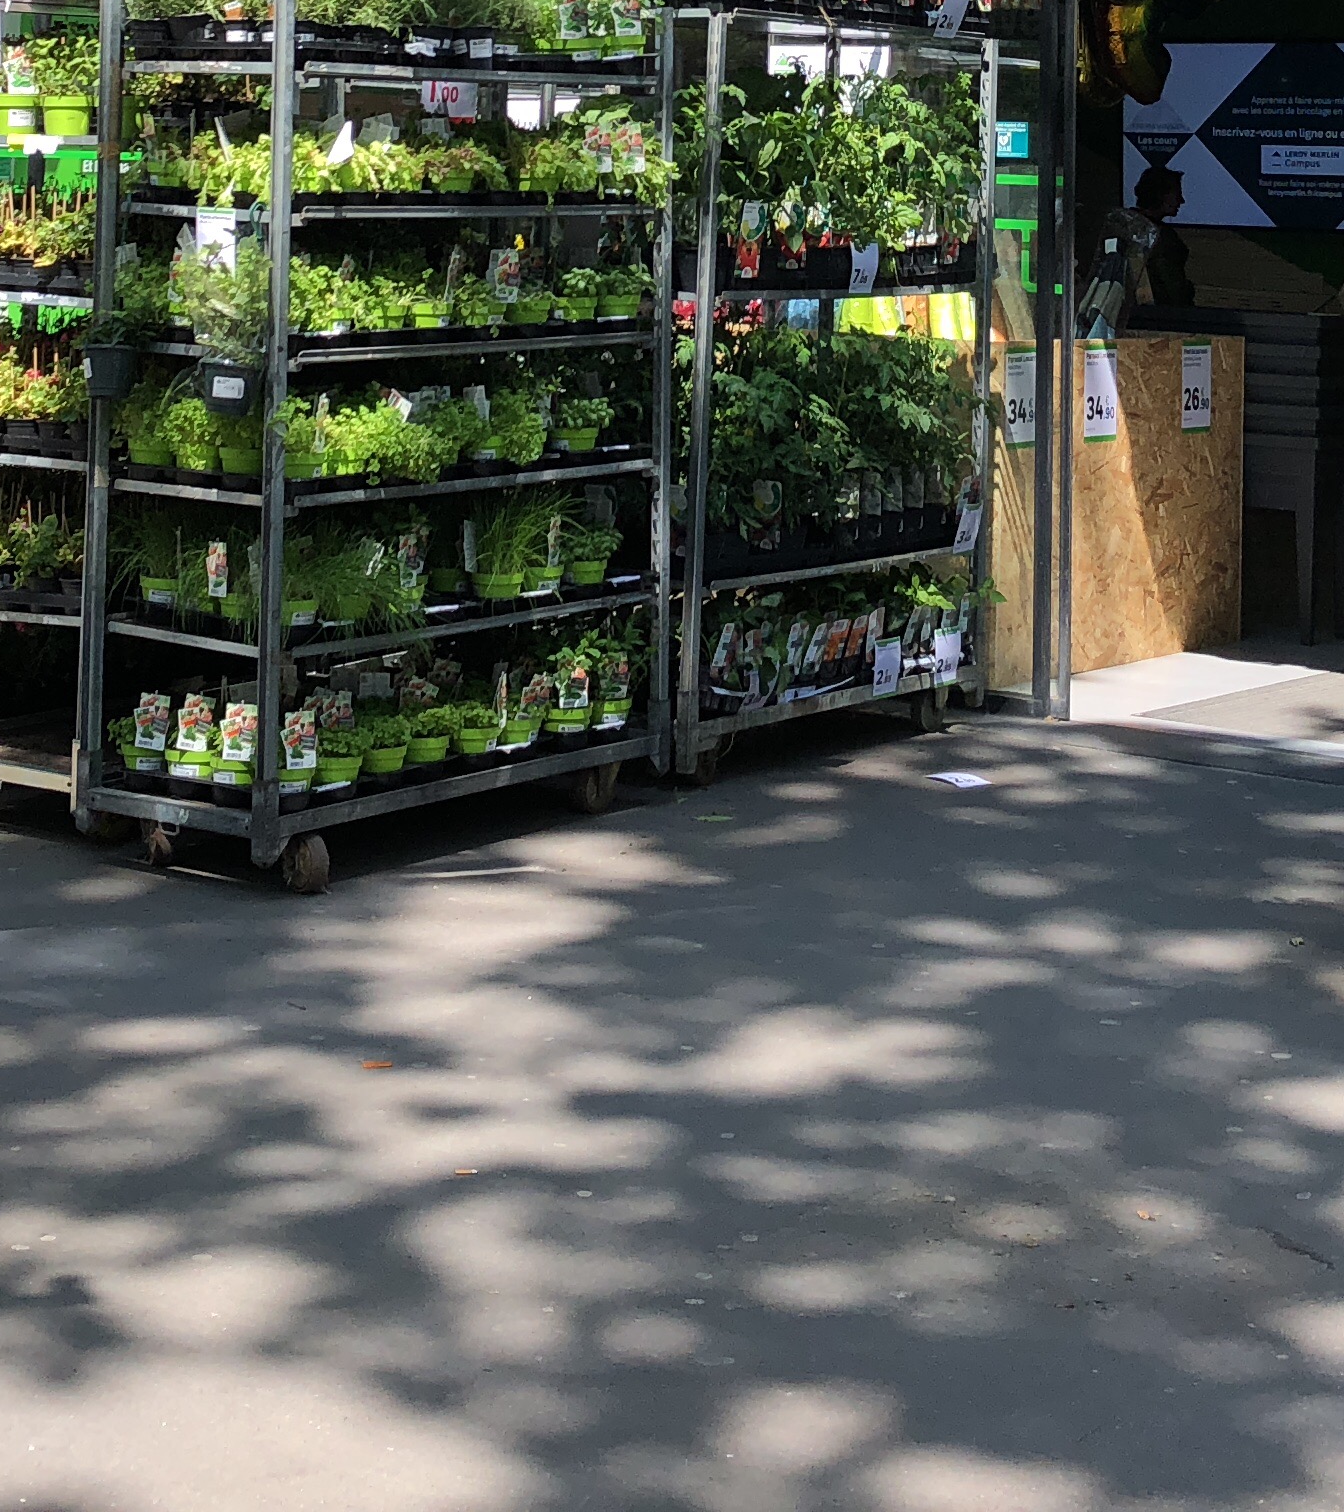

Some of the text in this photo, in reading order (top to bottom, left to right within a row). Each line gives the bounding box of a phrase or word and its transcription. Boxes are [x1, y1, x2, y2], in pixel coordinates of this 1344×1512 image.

[1212, 127, 1283, 138] Inscrivez-vous
[1284, 129, 1297, 138] en
[1298, 128, 1324, 140] ligne
[1325, 130, 1338, 139] ou
[1284, 150, 1340, 159] LEROY MERLIN
[1284, 159, 1321, 169] Campus
